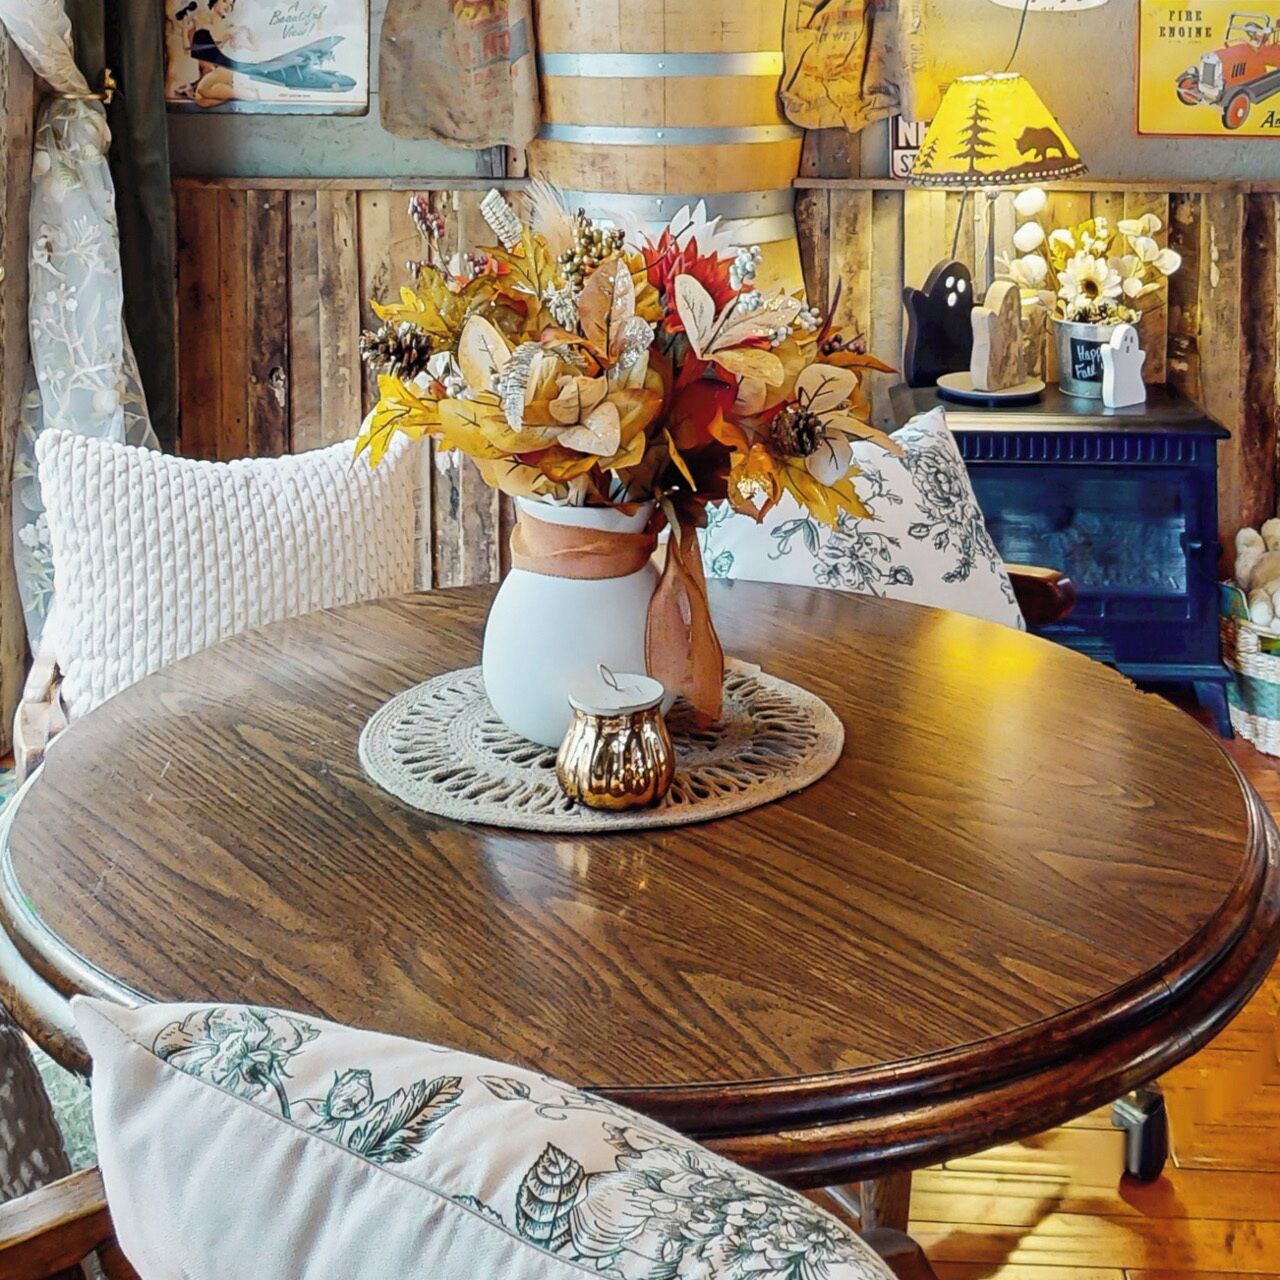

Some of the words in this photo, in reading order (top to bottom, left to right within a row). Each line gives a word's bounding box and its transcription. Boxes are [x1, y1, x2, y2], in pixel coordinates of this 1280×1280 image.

[288, 1, 299, 13] A
[269, 5, 328, 27] Beautiful
[1169, 10, 1203, 22] FIRE
[282, 23, 316, 39] View!
[1159, 26, 1213, 38] ENGINE
[1077, 344, 1101, 363] Happ
[1075, 363, 1098, 379] Fall
